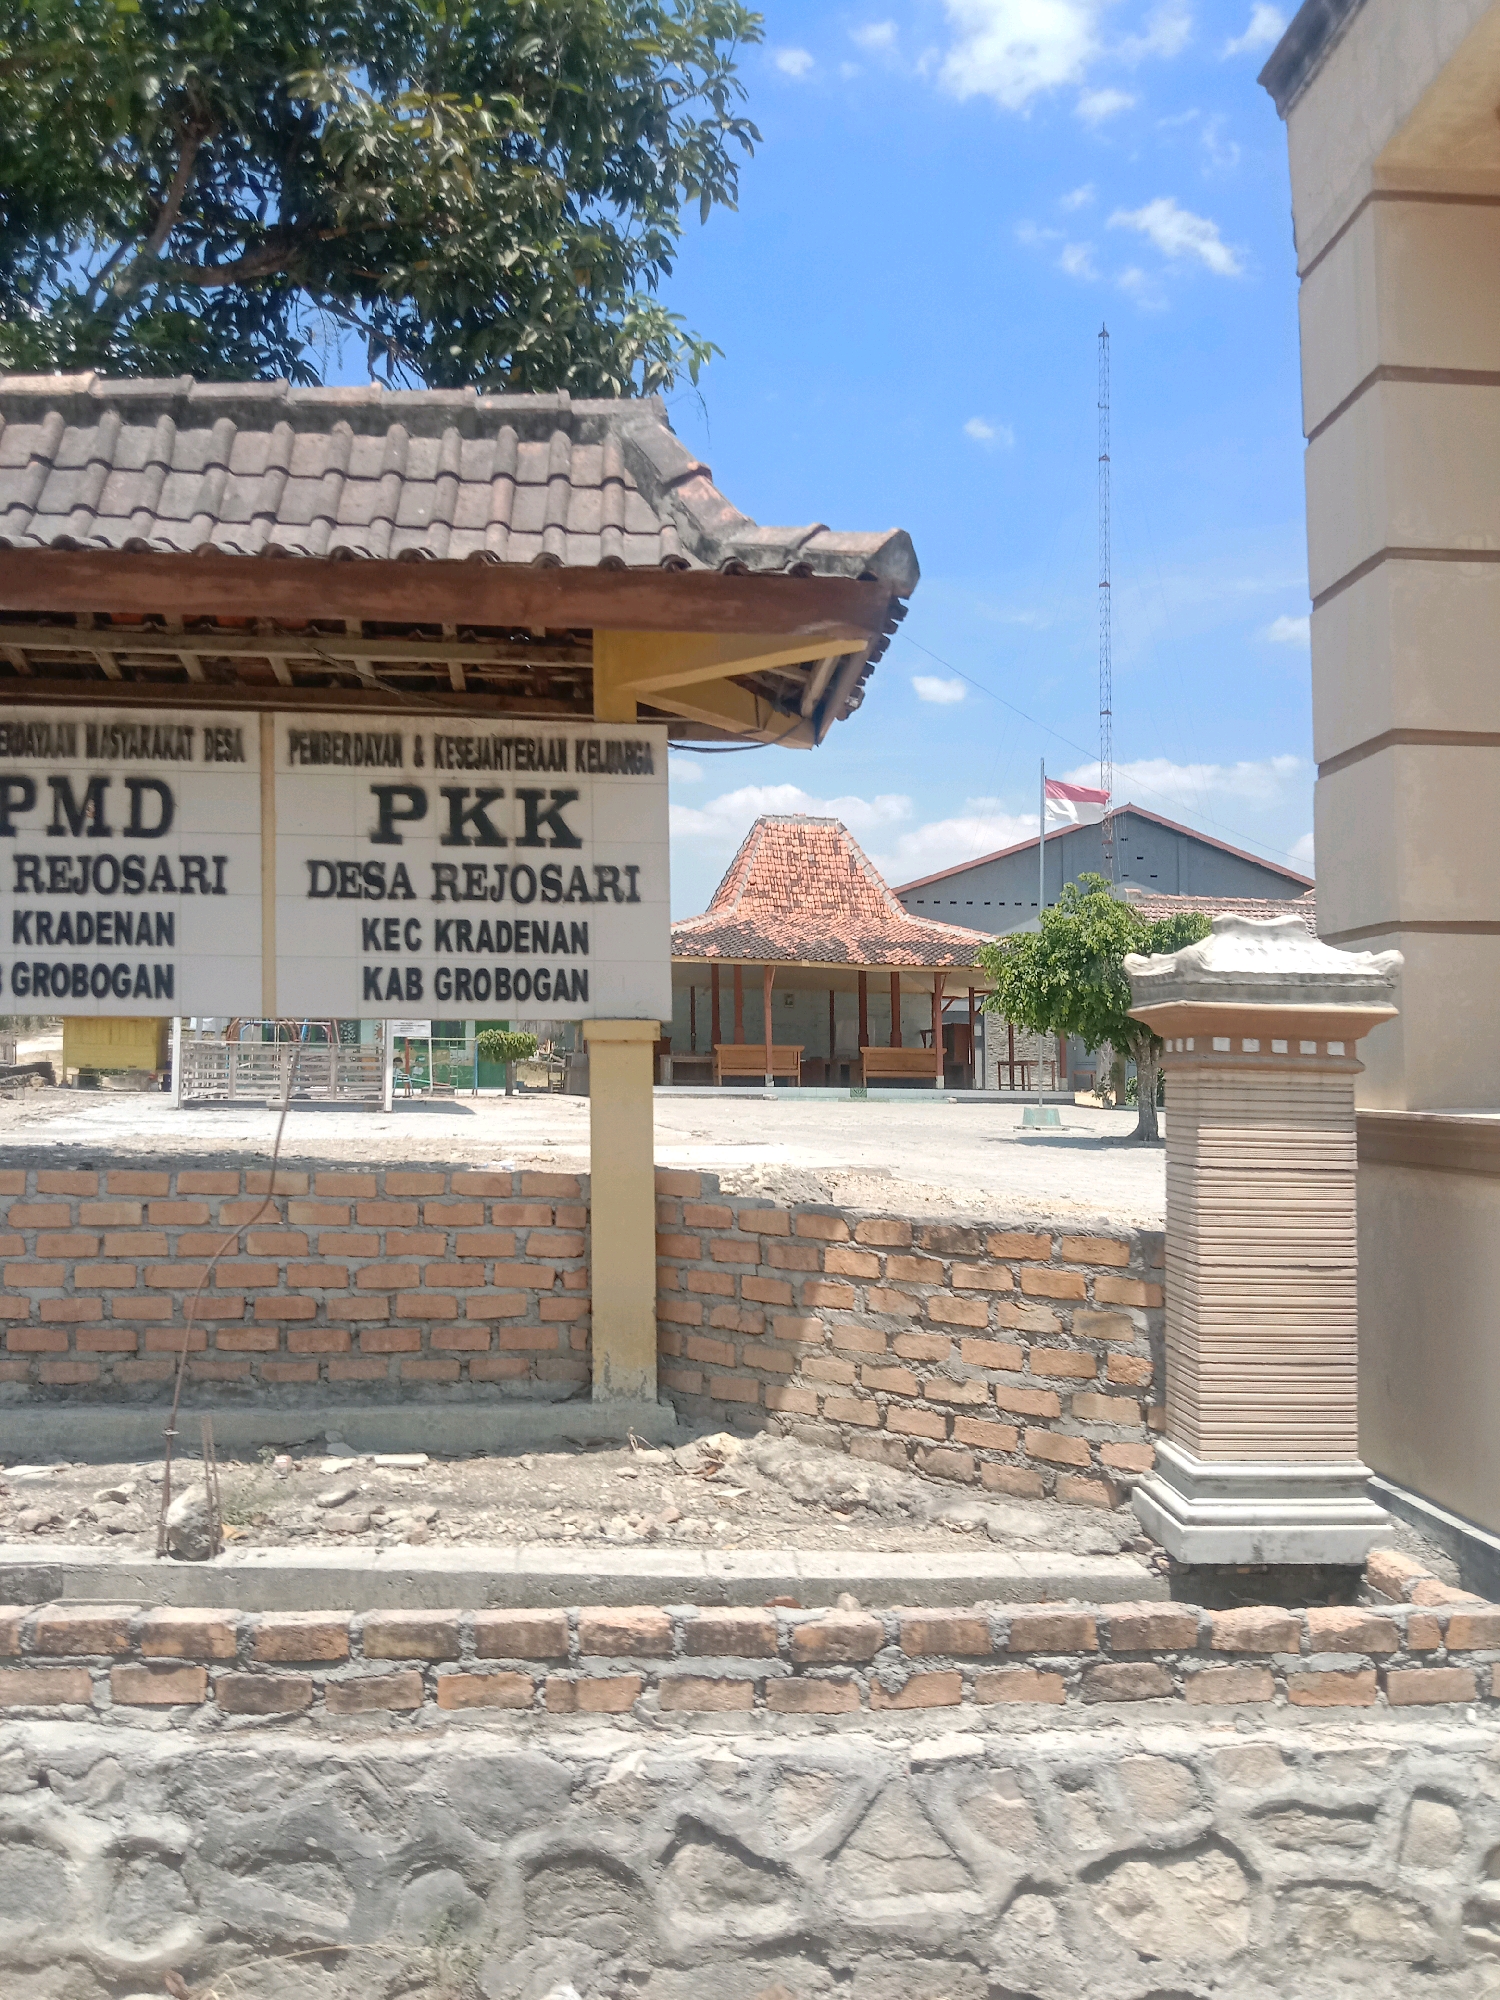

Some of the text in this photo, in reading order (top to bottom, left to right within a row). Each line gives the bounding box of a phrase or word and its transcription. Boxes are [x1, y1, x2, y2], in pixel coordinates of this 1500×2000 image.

[203, 726, 245, 762] DESA
[434, 733, 567, 772] KESEJAHTERAAN
[576, 738, 654, 775] KELUARGA
[369, 784, 582, 848] PKK
[13, 854, 229, 895] REJOSARI
[306, 859, 641, 903] DESA REJOSARI
[13, 910, 175, 947] KRADENAN
[362, 917, 589, 955] KEC KRADENAN
[11, 961, 175, 1000] GROBOGAN
[363, 966, 589, 1003] KAB GROBOGAN
